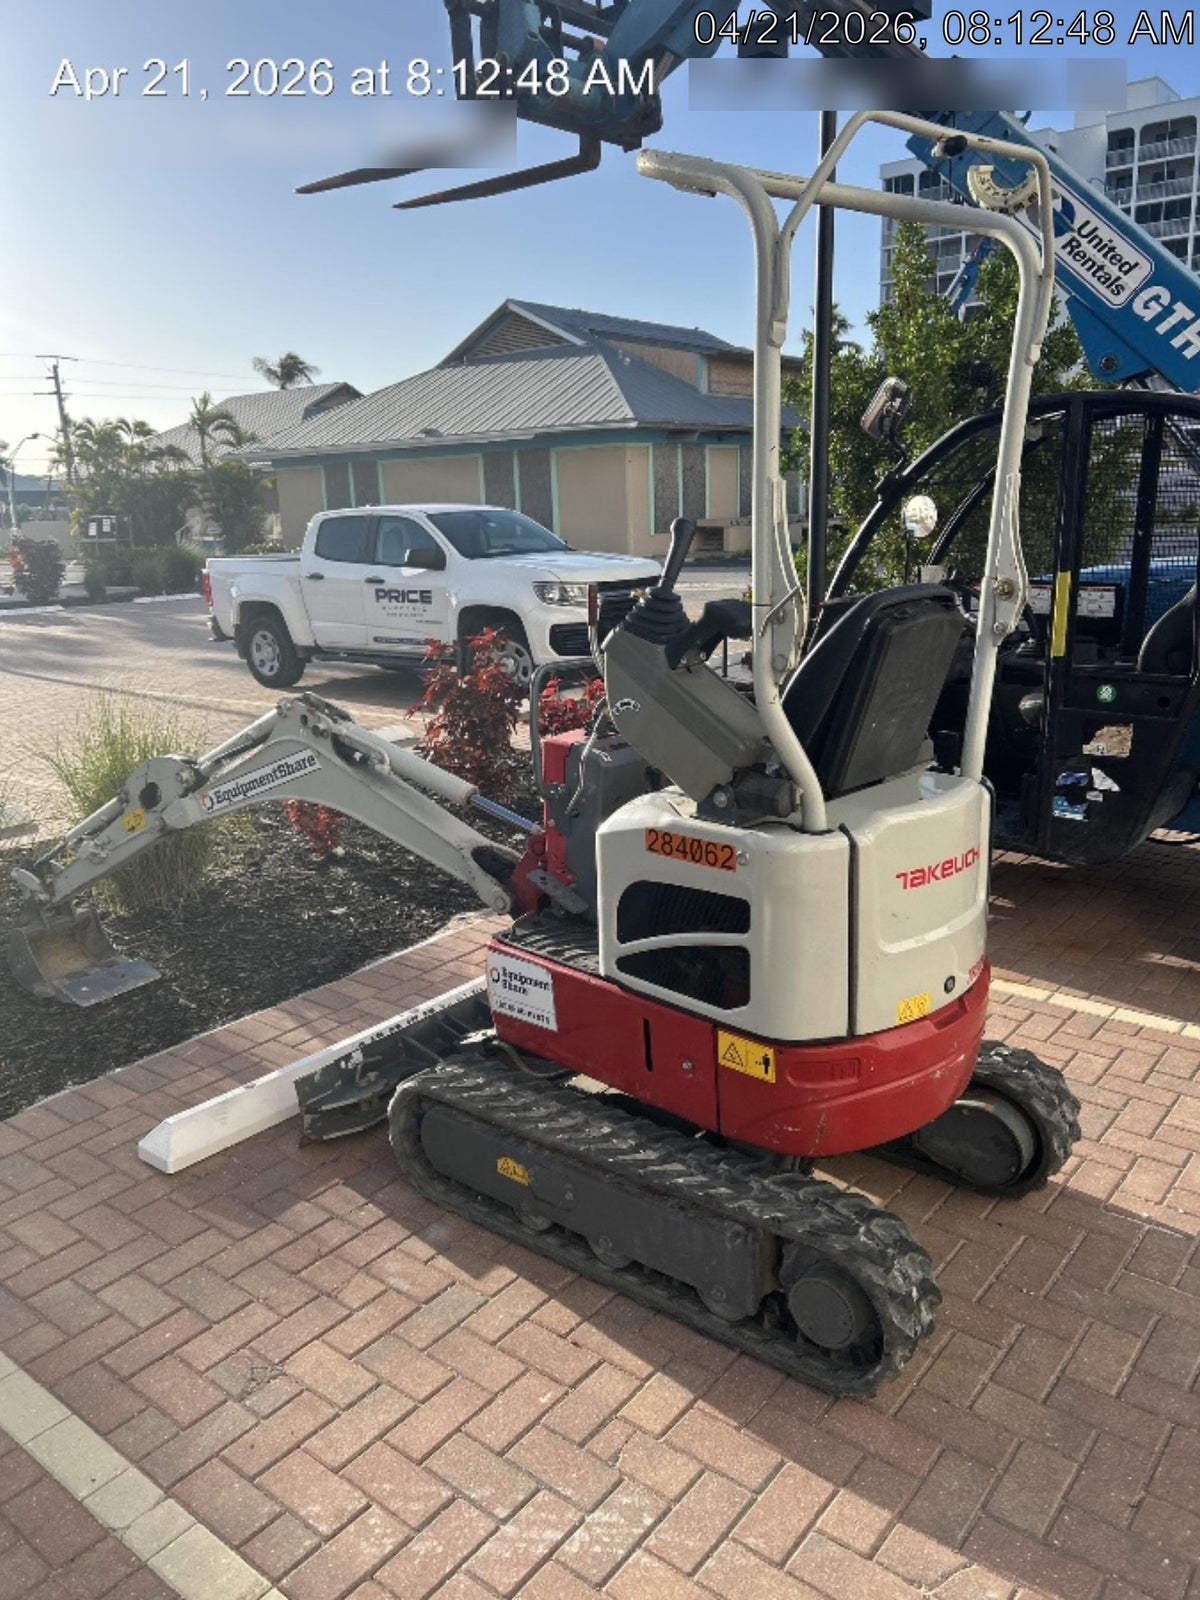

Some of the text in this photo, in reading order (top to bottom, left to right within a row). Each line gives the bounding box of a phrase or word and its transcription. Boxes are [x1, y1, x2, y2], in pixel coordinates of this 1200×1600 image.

[1060, 235, 1127, 297] Rentals
[1077, 219, 1141, 276] United
[374, 588, 433, 605] PRICE
[213, 754, 317, 804] EquipmentShare
[647, 828, 736, 871] 284062
